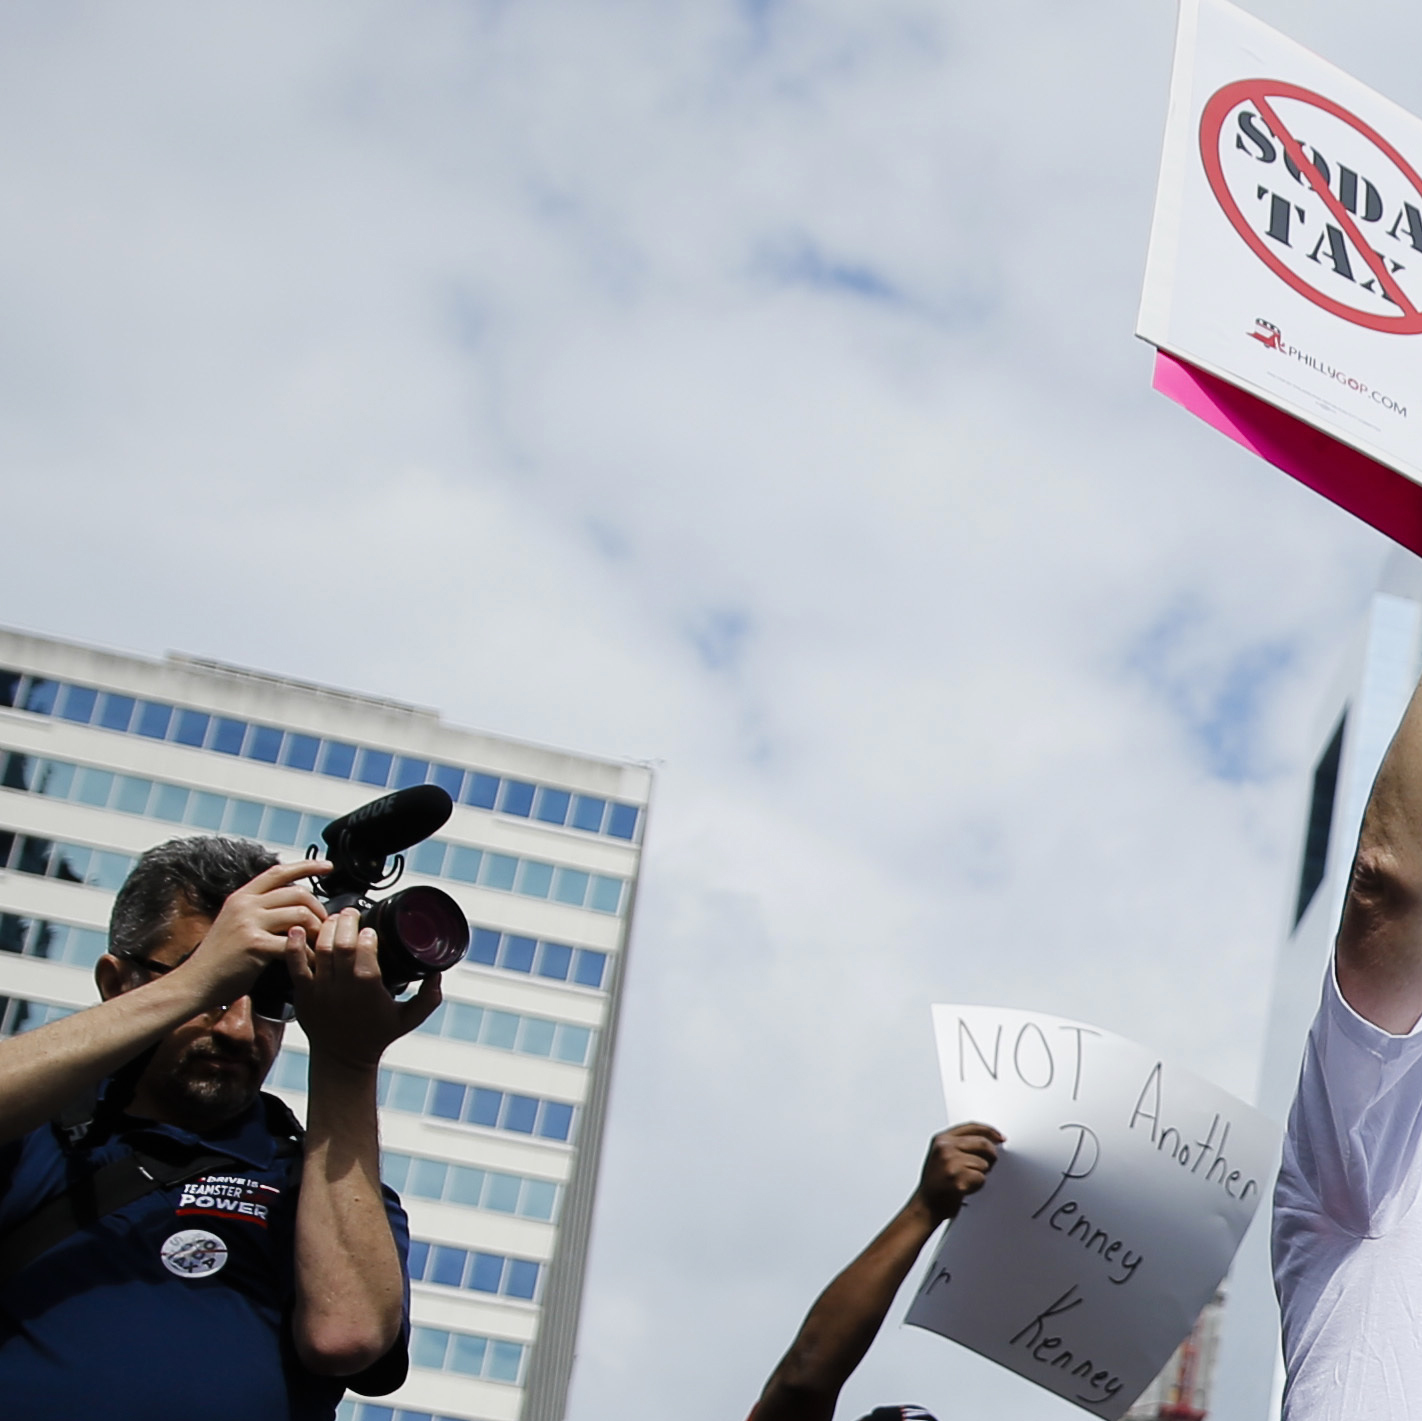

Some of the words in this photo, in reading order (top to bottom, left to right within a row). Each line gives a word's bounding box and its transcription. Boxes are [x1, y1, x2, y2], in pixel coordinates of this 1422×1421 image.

[1256, 185, 1405, 305] TAX
[1288, 345, 1408, 418] PHILLYGOP.COM
[957, 1016, 1101, 1101] NOT
[1128, 1061, 1259, 1201] Another
[179, 1193, 269, 1220] POWER
[183, 1183, 243, 1199] TEAMSTER
[206, 1175, 246, 1185] DRIVE
[1031, 1123, 1143, 1285] Penney
[1008, 1284, 1125, 1404] Kenney
